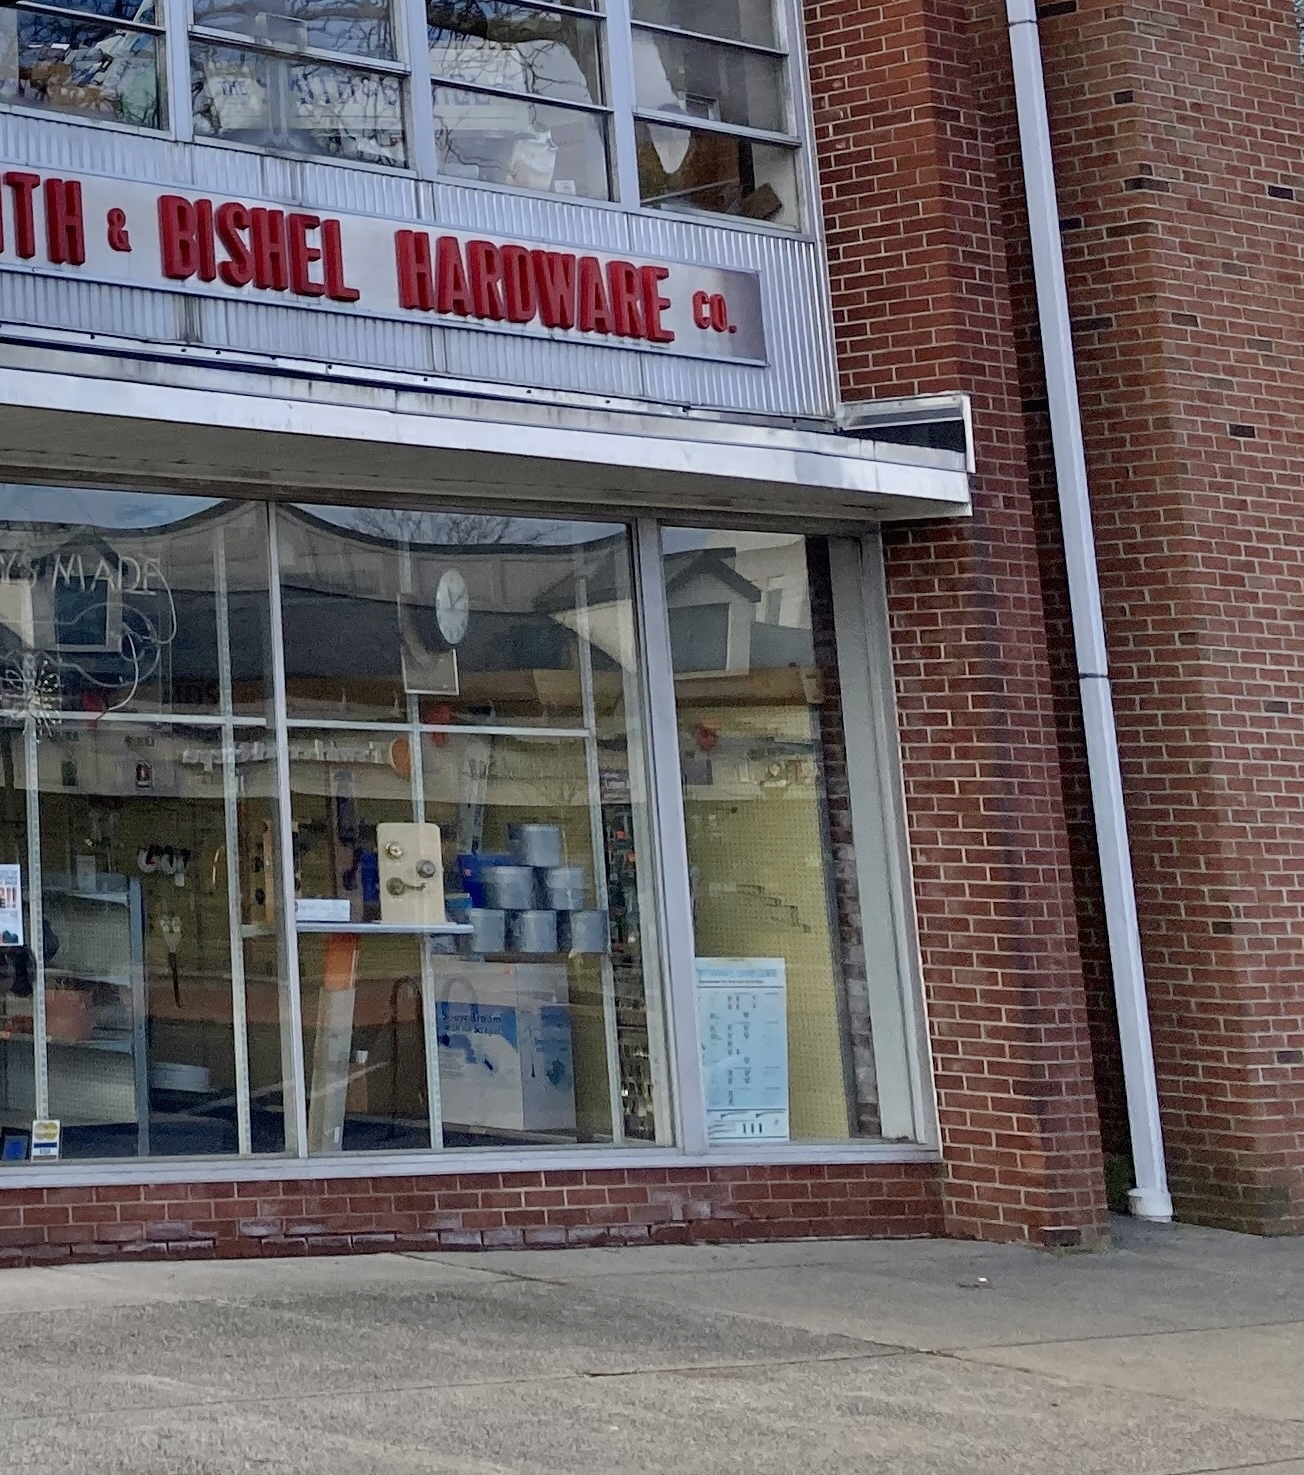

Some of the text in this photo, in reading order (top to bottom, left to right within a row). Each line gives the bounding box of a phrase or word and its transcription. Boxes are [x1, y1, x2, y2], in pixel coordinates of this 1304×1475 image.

[106, 207, 132, 253] &
[157, 194, 361, 303] BISHEL
[394, 229, 676, 344] HARDWARE
[693, 289, 738, 335] CO.
[51, 552, 162, 596] MADE
